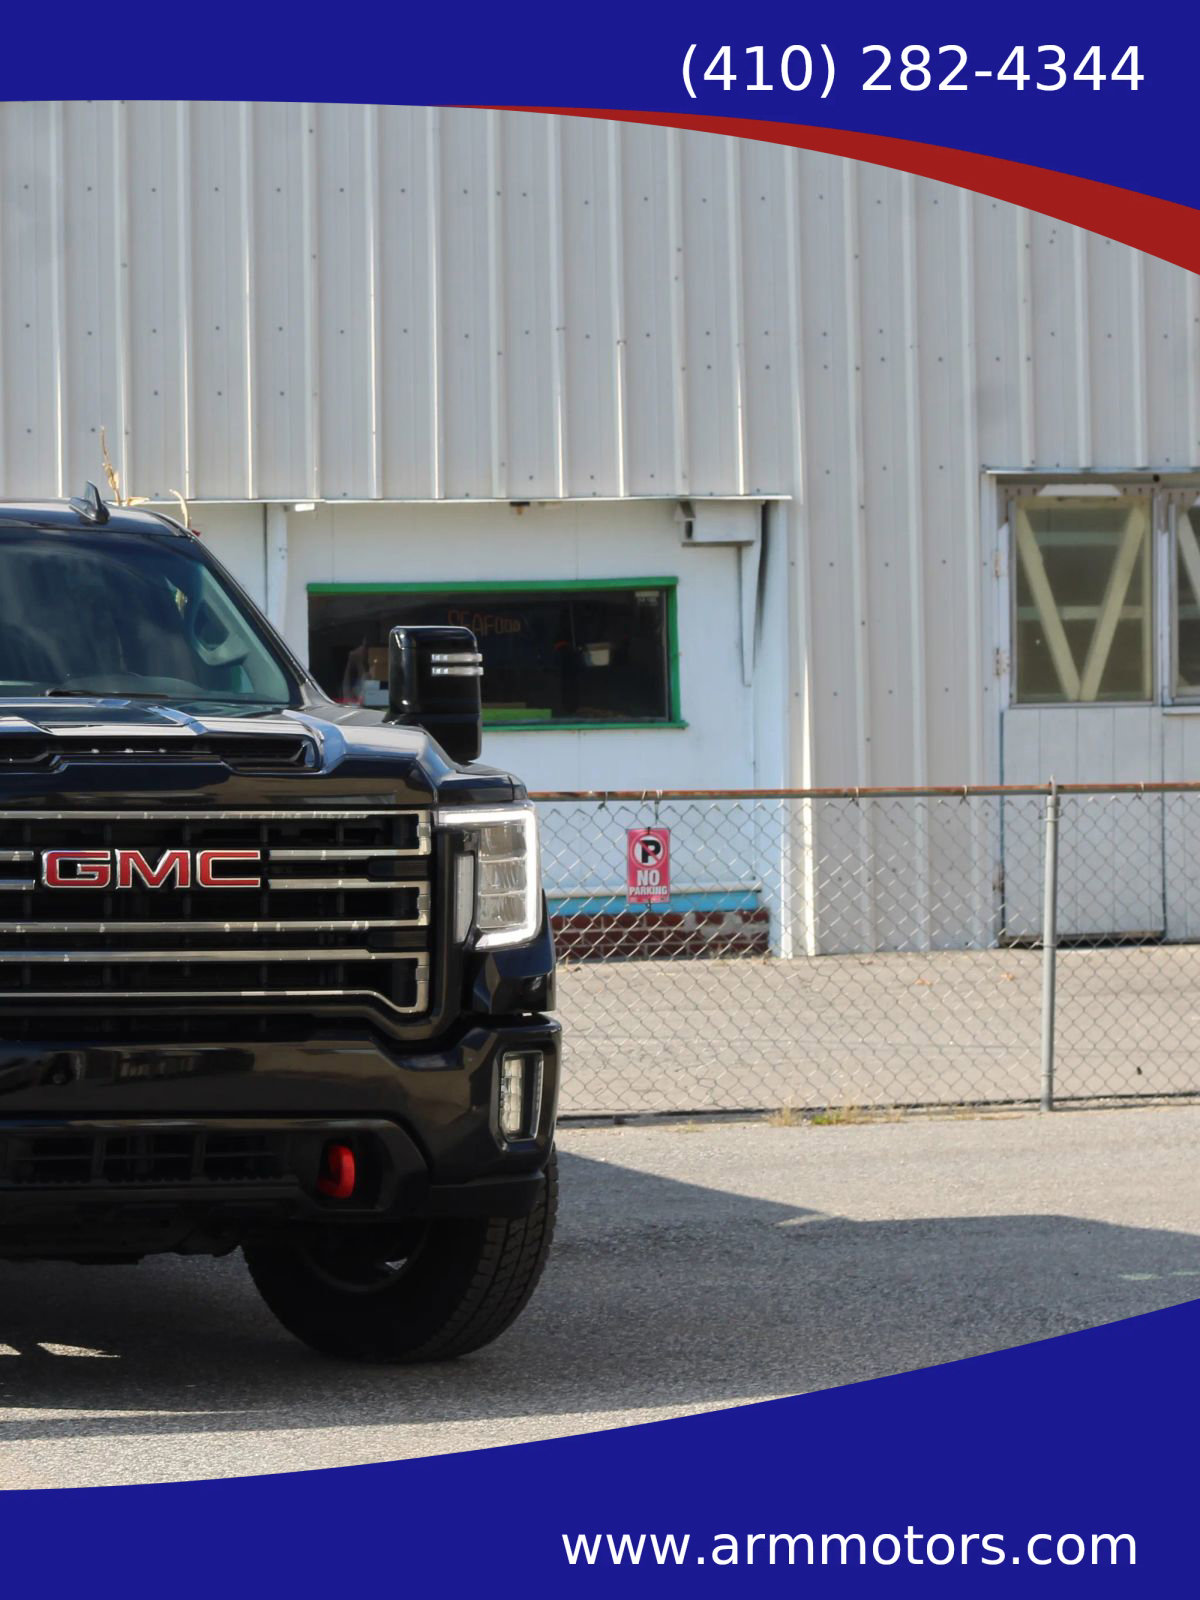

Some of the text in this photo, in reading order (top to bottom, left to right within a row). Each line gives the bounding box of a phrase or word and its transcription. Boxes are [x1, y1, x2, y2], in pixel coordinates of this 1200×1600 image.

[41, 849, 261, 888] GMC
[637, 869, 660, 886] NO
[629, 886, 668, 896] PARKING
